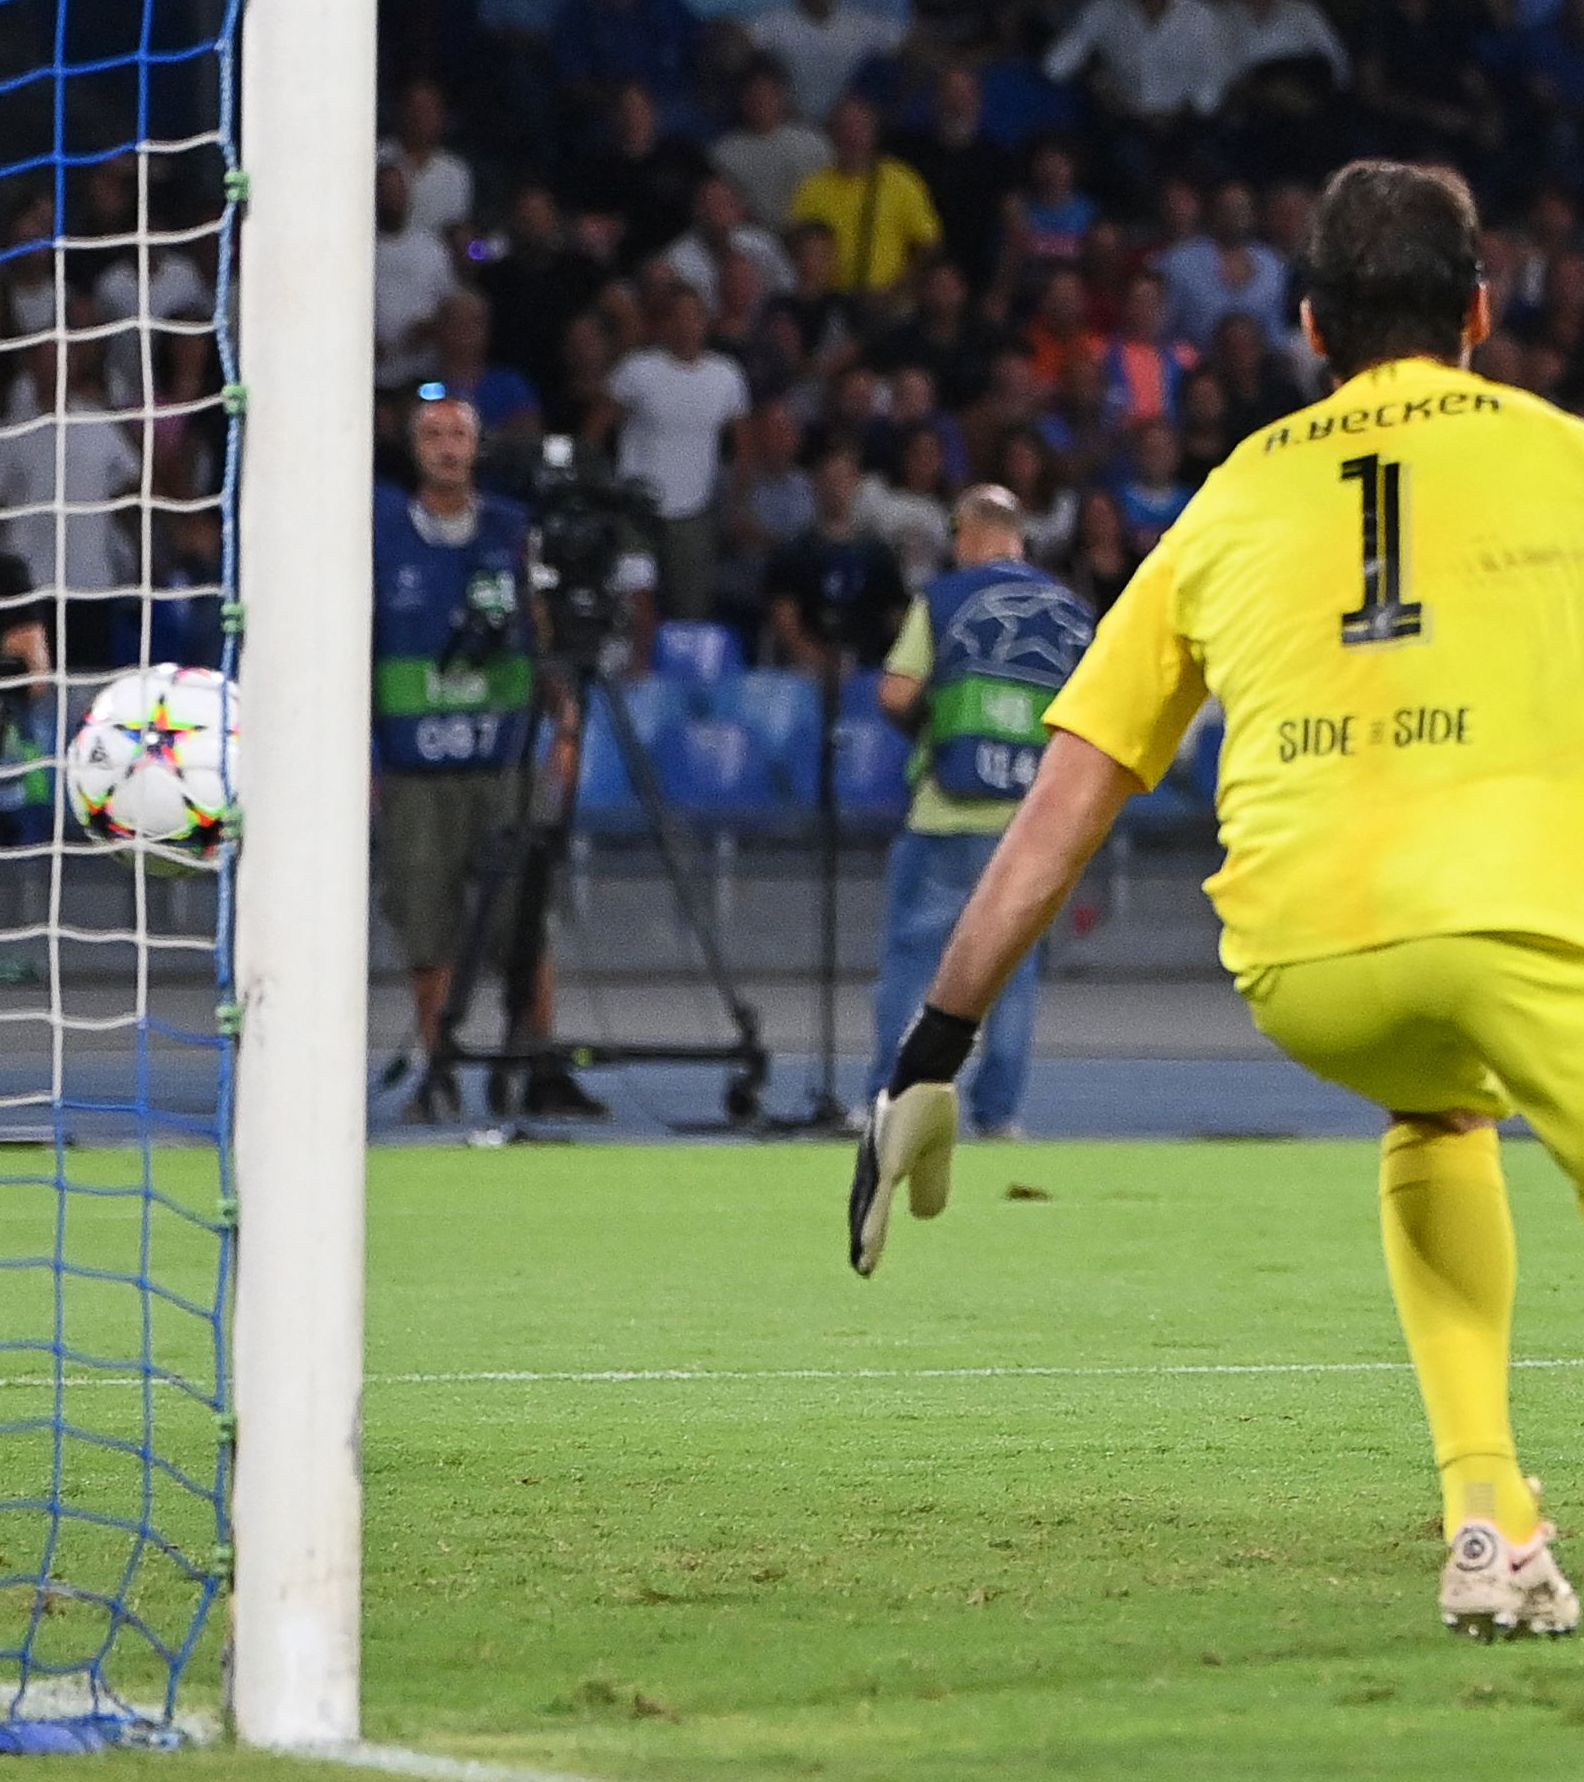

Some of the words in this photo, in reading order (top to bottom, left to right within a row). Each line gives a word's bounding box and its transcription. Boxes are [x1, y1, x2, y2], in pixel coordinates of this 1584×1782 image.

[1341, 453, 1422, 646] 1
[1279, 715, 1355, 763] SIDE
[1393, 706, 1471, 748] SIDE
